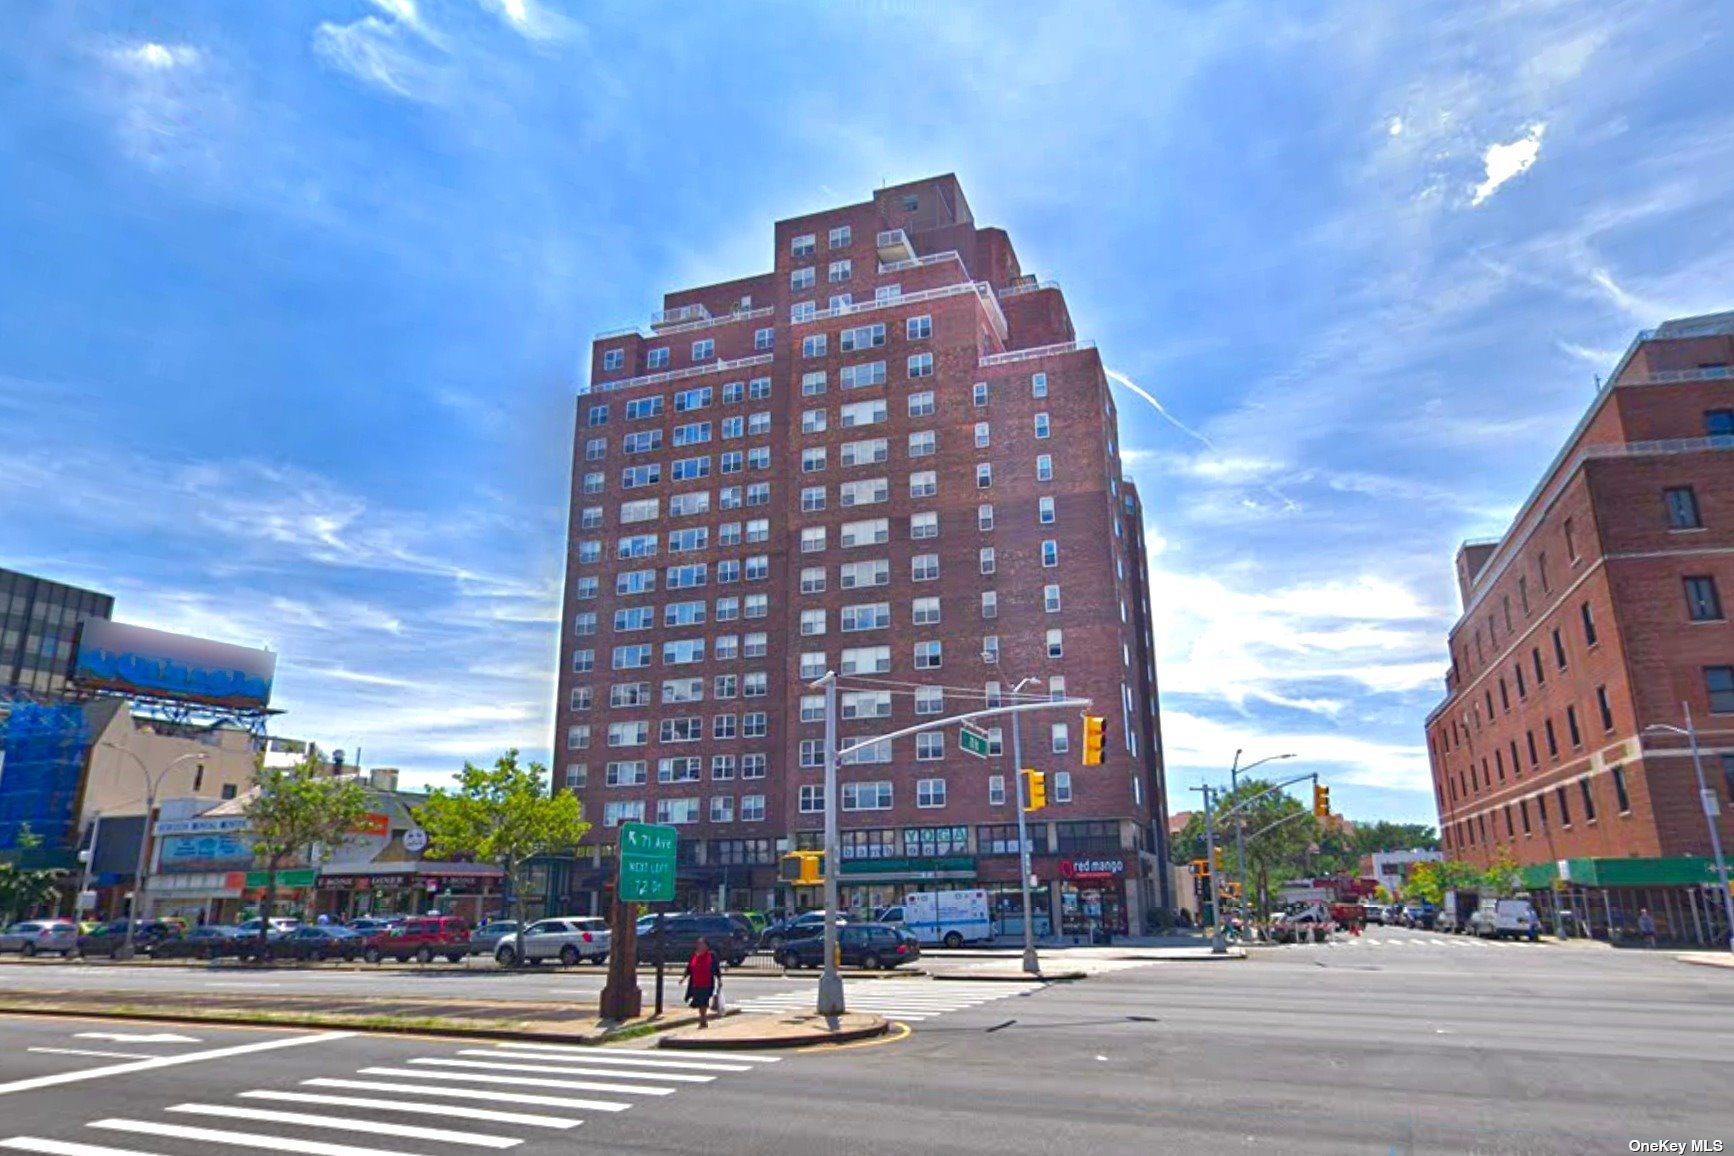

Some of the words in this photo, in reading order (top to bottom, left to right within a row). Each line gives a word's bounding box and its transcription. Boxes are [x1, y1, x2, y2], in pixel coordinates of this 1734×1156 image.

[641, 834, 651, 848] 71
[655, 836, 672, 849] Ave
[907, 828, 965, 842] YOGA
[629, 862, 648, 873] NEXT
[650, 863, 668, 874] LEFT
[1073, 859, 1090, 872] red
[1091, 860, 1124, 873] mango
[635, 880, 648, 895] 72
